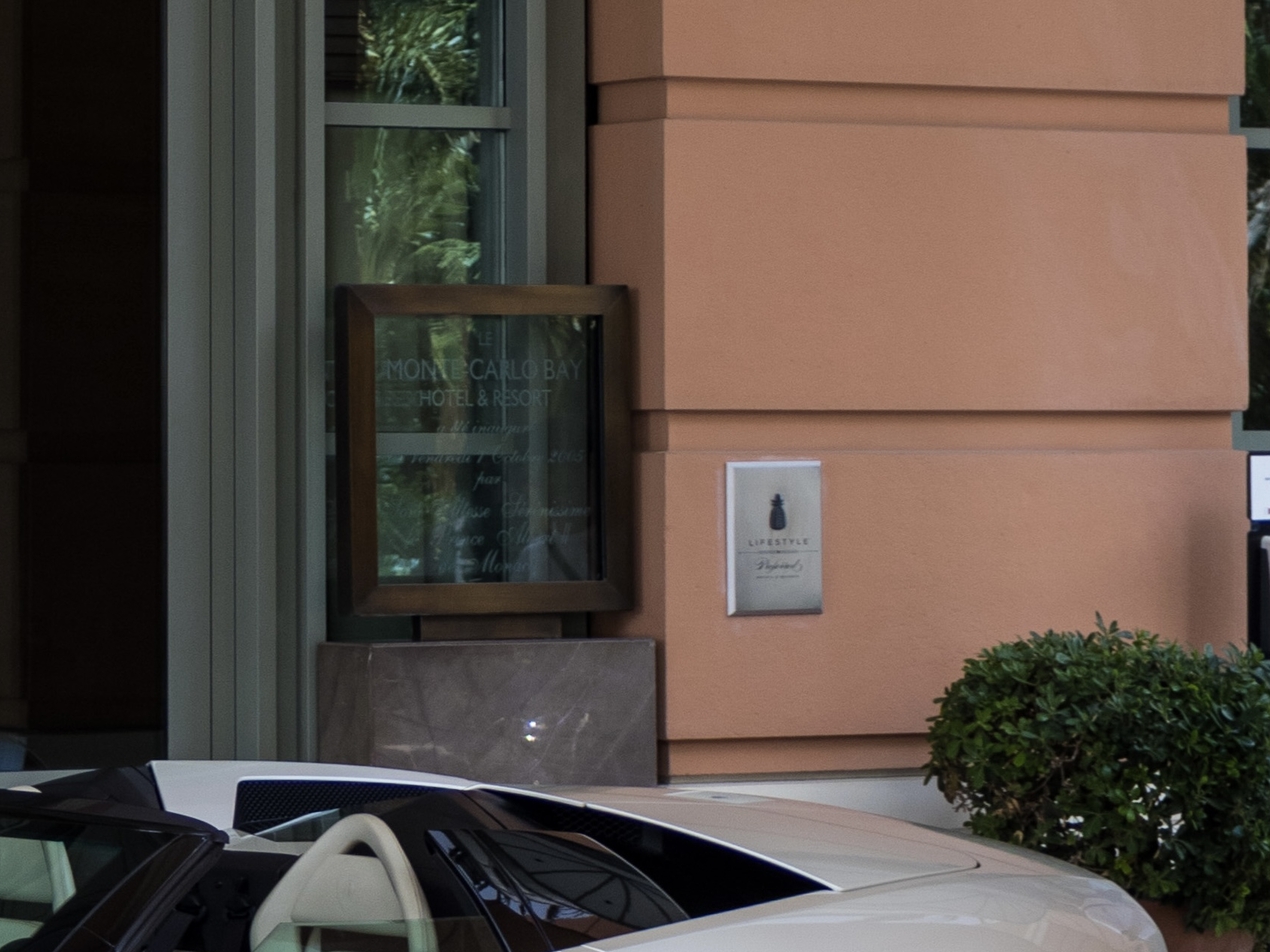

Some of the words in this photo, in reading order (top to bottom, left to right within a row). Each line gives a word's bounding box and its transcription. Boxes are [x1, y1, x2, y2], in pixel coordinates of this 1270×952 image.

[478, 331, 492, 346] LE
[386, 358, 537, 381] MONTE-CARLO
[544, 358, 582, 381] BAY
[418, 389, 474, 407] HOTEL
[477, 389, 488, 407] &
[493, 388, 552, 407] RESORT
[472, 472, 500, 492] par
[747, 537, 809, 547] LIFESTYLE
